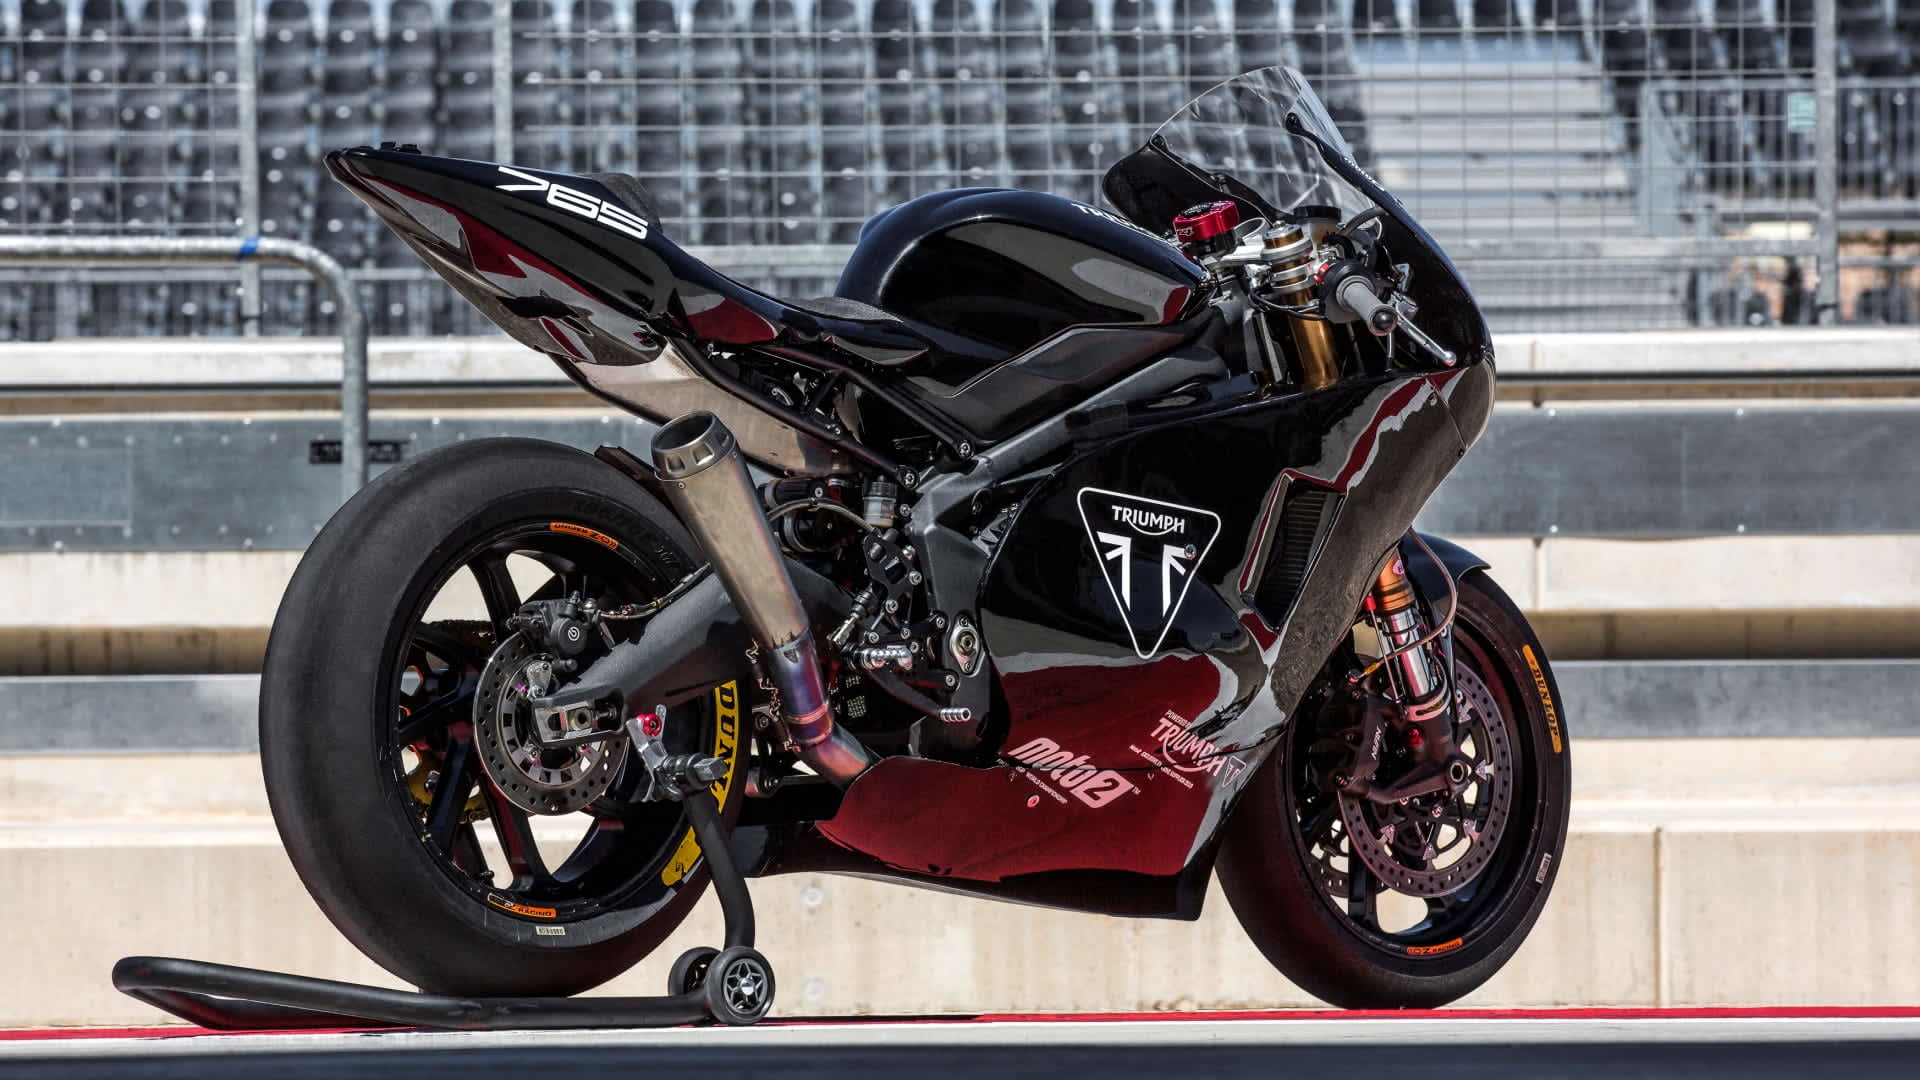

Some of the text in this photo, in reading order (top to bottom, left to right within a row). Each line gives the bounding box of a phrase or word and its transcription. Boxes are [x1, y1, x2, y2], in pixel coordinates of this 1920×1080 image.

[496, 166, 649, 240] 765
[1111, 505, 1185, 535] TRIUMPH
[1534, 668, 1559, 736] DUNLOP
[1150, 717, 1228, 777] TRIUMPH
